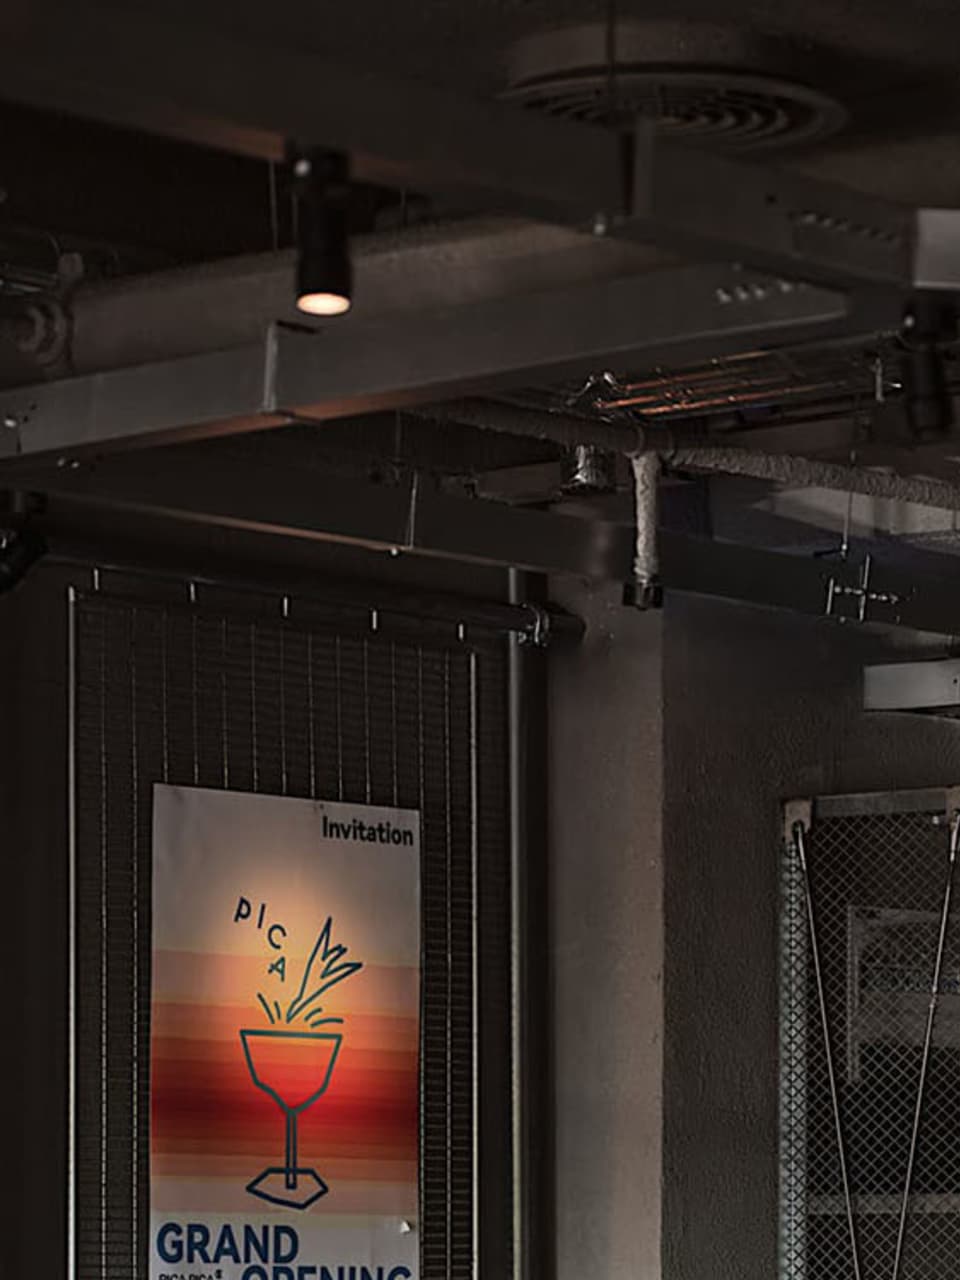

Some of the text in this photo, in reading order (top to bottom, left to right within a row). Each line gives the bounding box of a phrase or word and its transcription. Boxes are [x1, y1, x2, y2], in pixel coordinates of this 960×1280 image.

[321, 815, 414, 846] Invitation
[233, 896, 287, 982] PICA
[156, 1222, 299, 1264] GRAND
